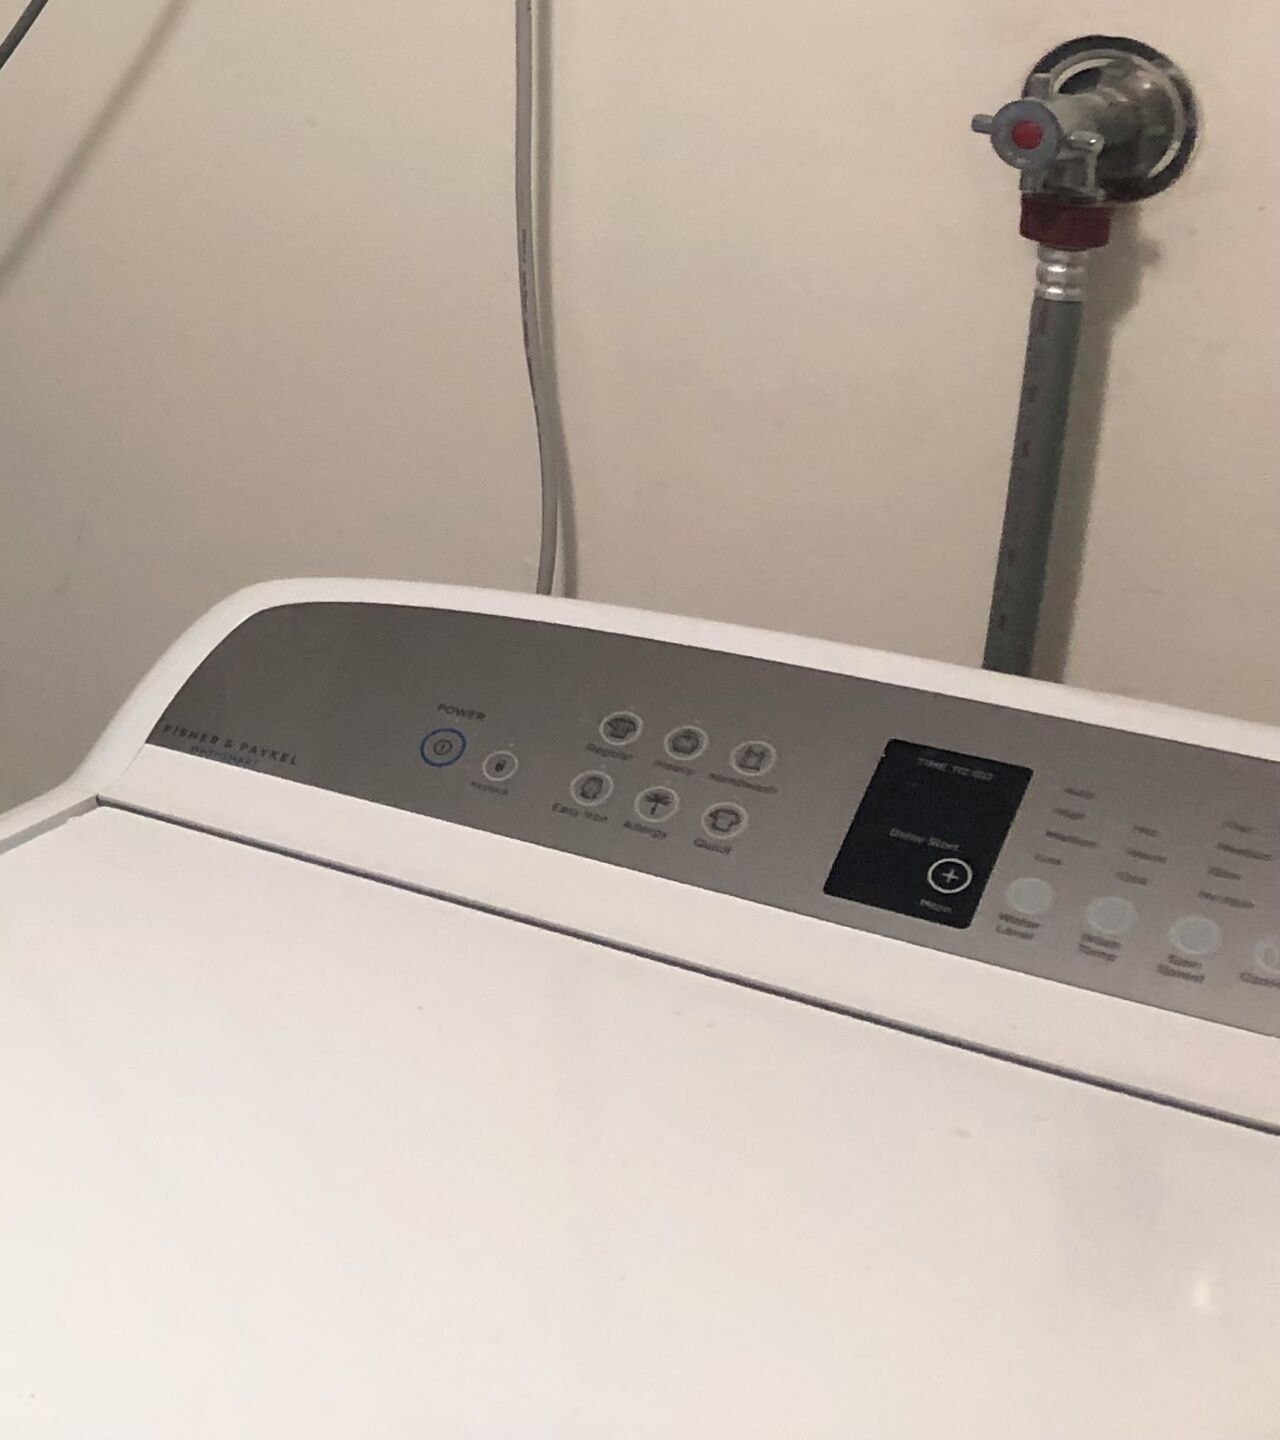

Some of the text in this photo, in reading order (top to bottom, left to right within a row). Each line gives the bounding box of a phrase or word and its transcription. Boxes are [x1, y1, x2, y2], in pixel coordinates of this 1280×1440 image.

[436, 703, 486, 722] POWER
[161, 724, 298, 766] FISHER & PAYKEL
